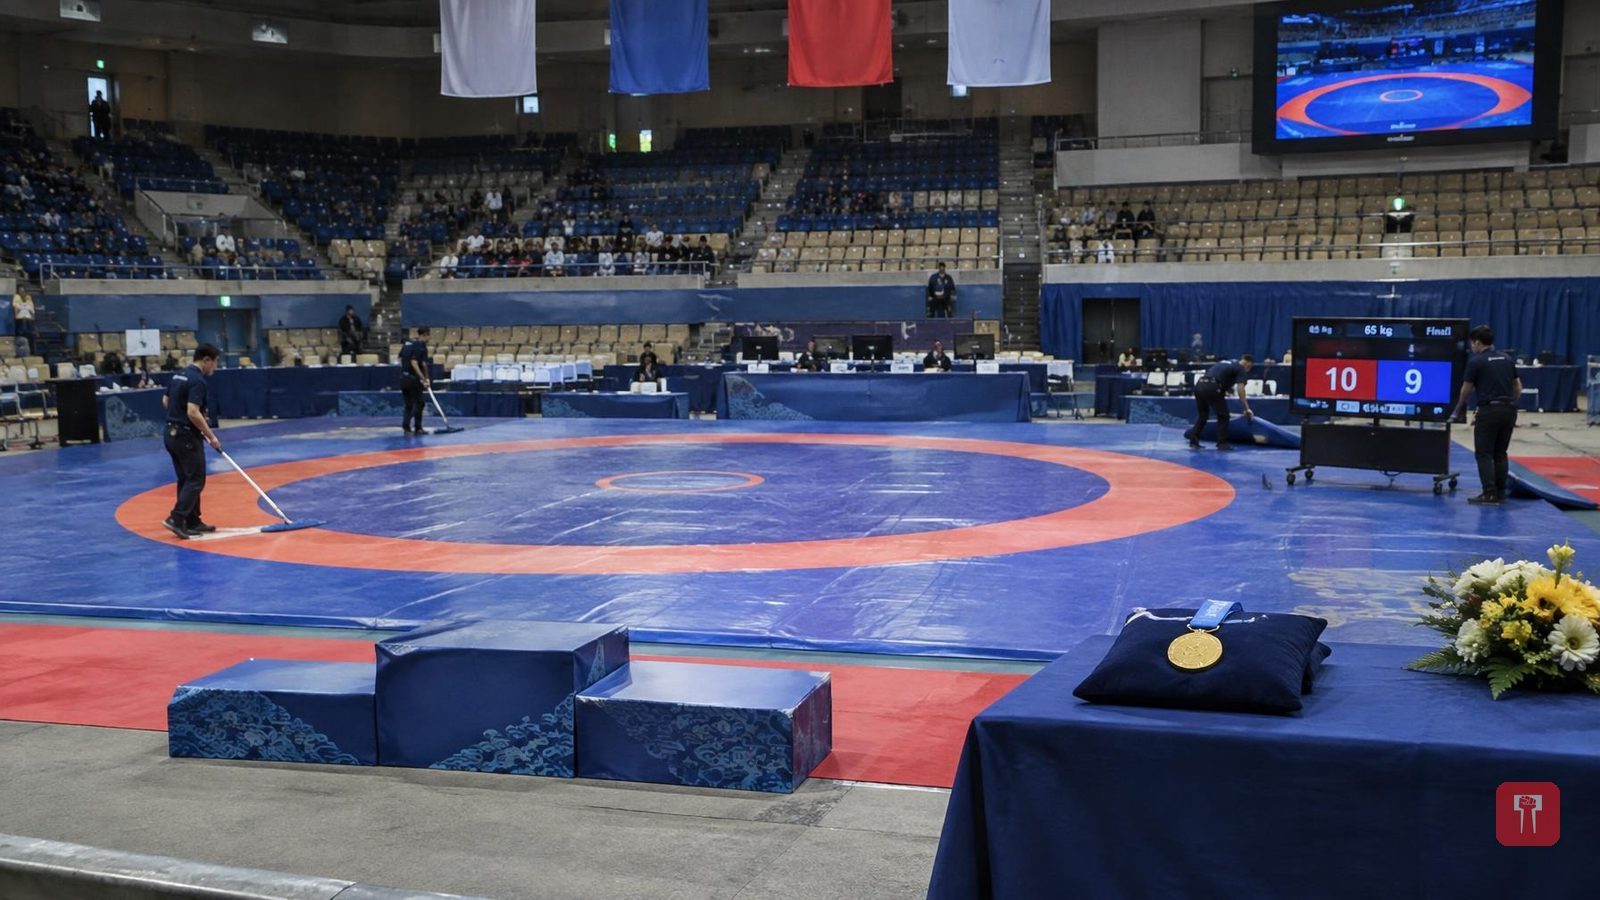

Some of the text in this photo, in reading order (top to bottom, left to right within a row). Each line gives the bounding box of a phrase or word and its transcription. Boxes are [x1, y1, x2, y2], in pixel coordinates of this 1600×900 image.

[1364, 325, 1393, 337] 65 kg
[1325, 367, 1357, 391] 10
[1405, 369, 1422, 394] 9
